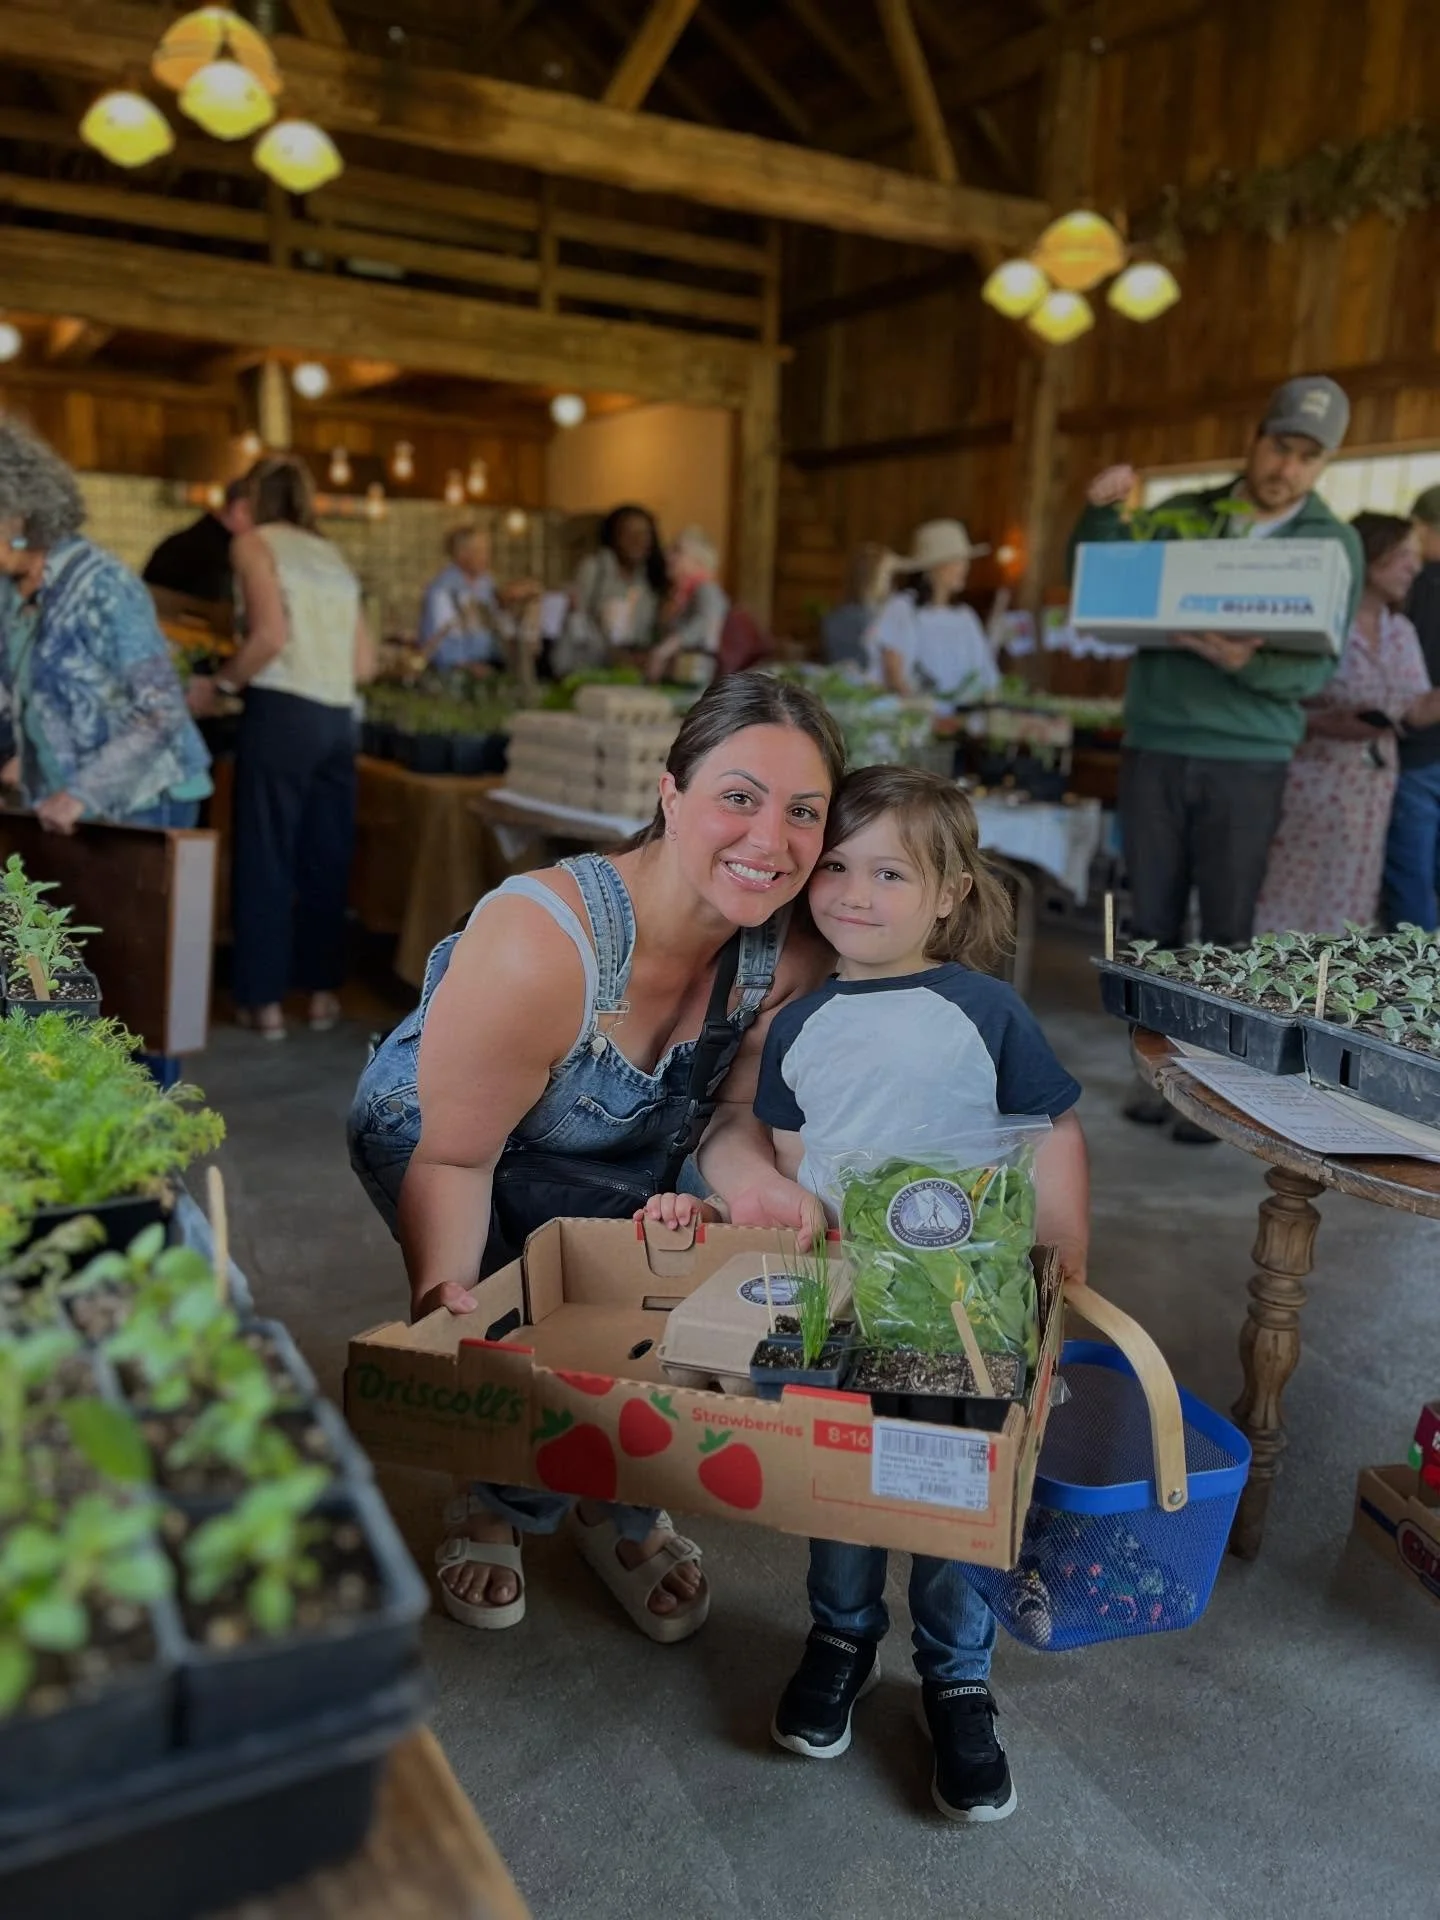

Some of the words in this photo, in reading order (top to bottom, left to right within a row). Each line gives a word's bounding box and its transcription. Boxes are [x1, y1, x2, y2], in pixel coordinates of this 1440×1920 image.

[892, 1182, 951, 1217] STONEWOOD
[953, 1190, 970, 1220] FARM
[357, 1362, 526, 1425] Driscoll's
[692, 1407, 804, 1438] Strawberries
[828, 1425, 870, 1448] 8-16
